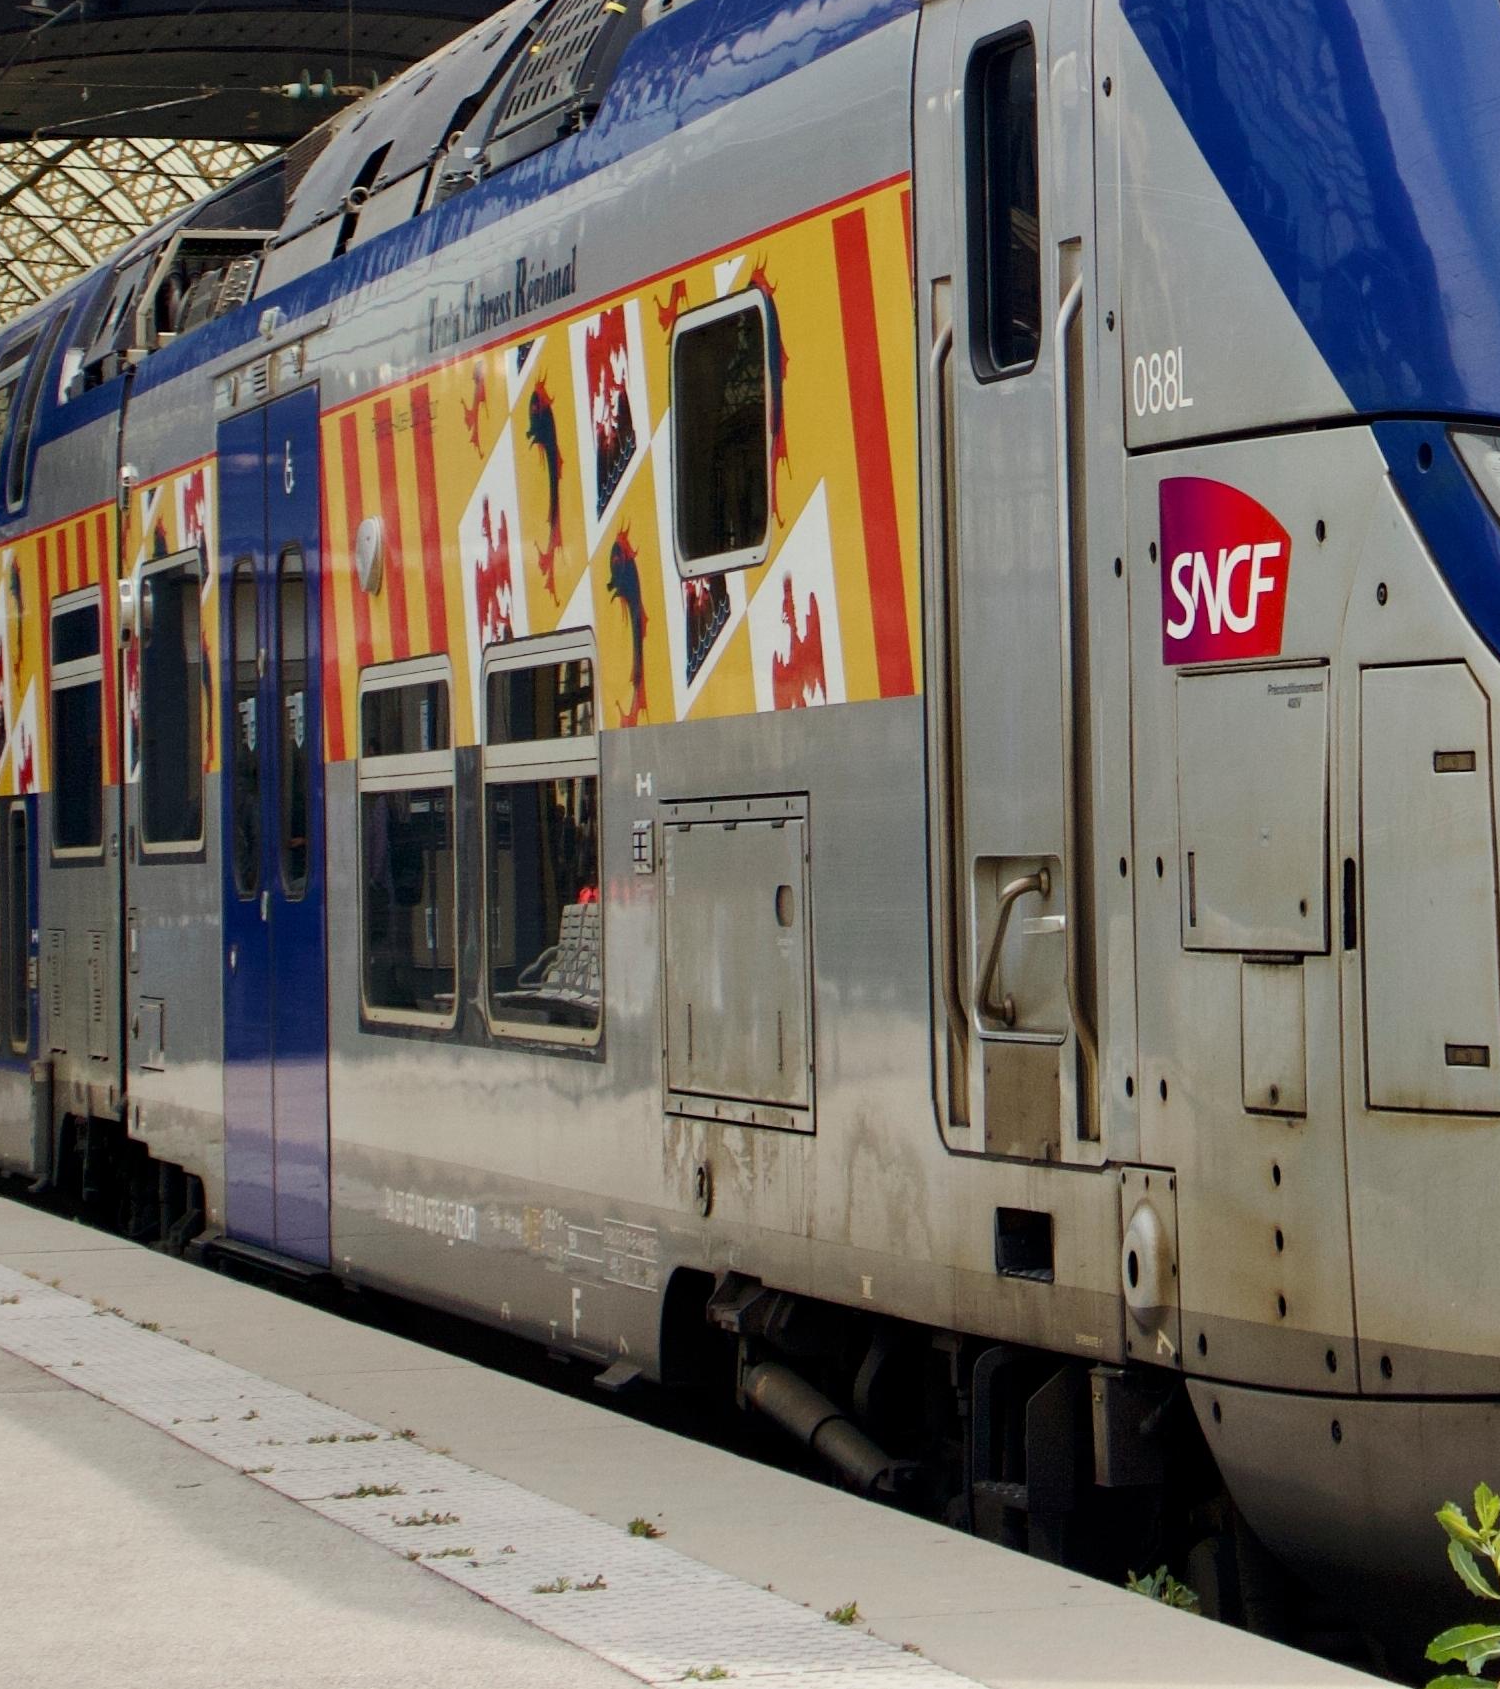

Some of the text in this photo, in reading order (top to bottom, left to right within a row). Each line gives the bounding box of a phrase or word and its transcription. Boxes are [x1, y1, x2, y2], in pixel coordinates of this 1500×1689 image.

[464, 280, 511, 339] Express
[515, 244, 577, 318] Régional
[1132, 346, 1194, 415] 088L
[1166, 541, 1282, 641] SNCF
